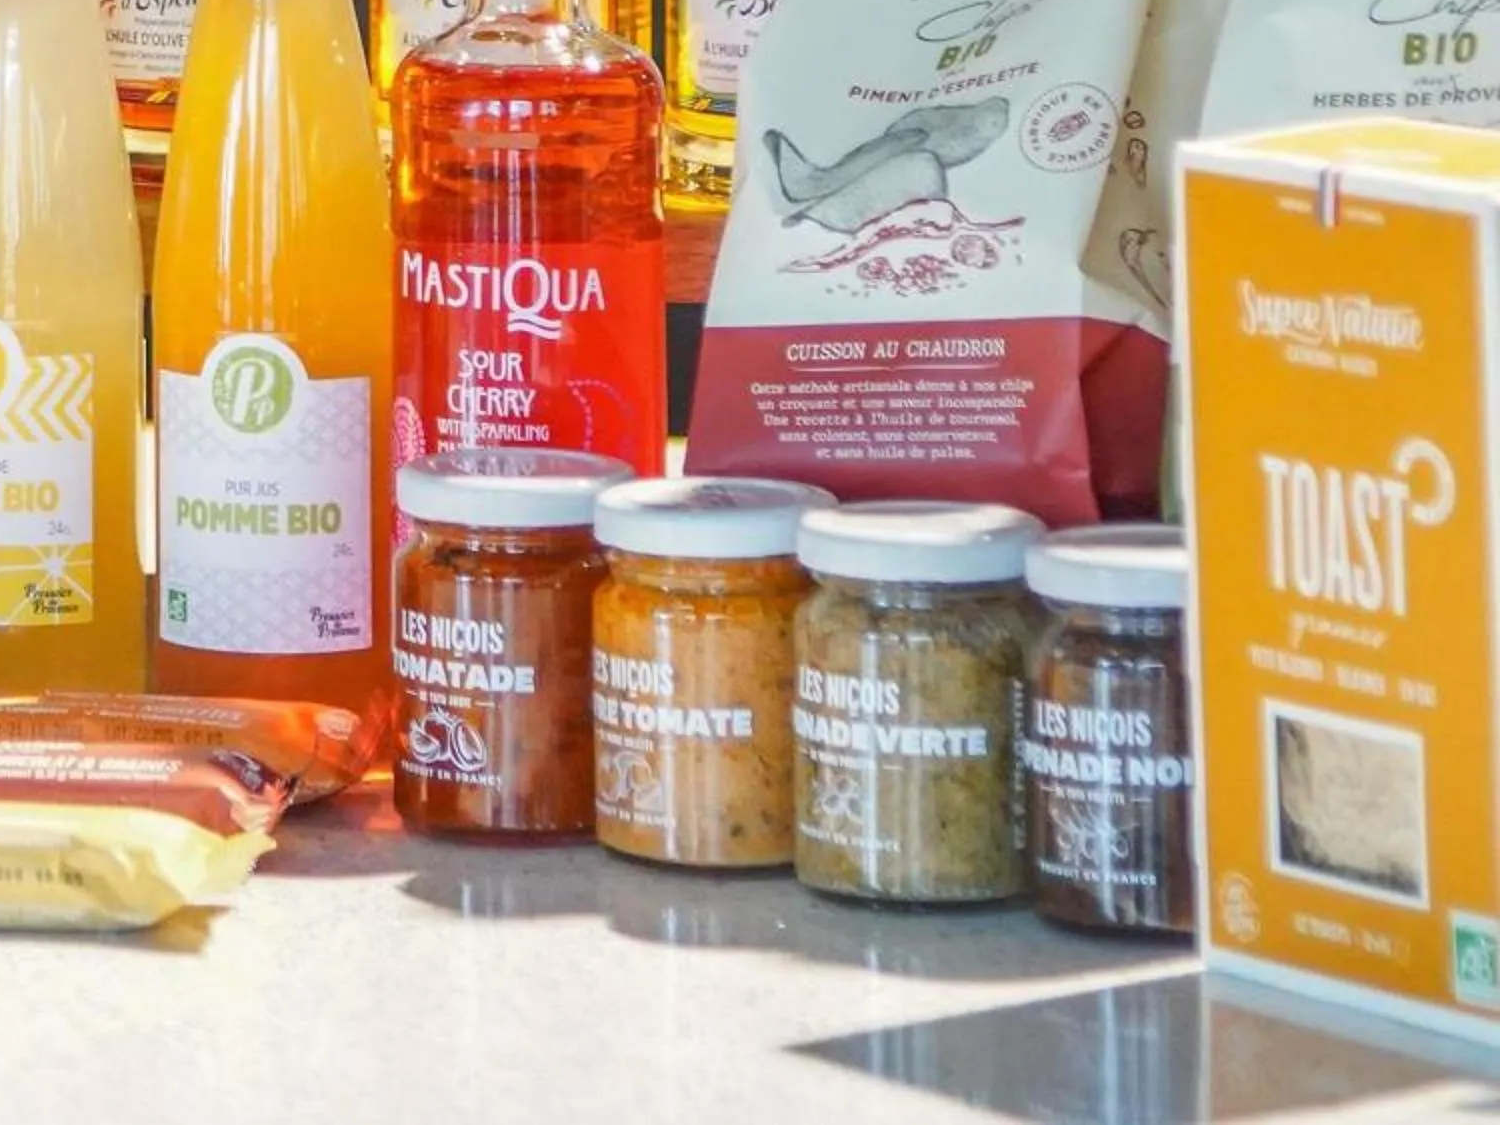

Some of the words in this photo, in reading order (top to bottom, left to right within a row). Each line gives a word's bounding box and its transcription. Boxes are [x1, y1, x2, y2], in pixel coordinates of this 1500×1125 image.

[936, 33, 997, 71] BIO
[1403, 32, 1478, 66] BIO
[848, 85, 924, 104] PIMENT
[928, 62, 1040, 100] D'ESPELETTE
[1313, 92, 1397, 109] HERBES
[1404, 91, 1433, 108] DE
[402, 250, 605, 339] MASTIQUA
[457, 348, 524, 382] SOUR
[786, 342, 866, 361] CUISSON
[873, 342, 899, 359] AU
[906, 339, 1006, 359] CHAUDRON
[446, 384, 536, 417] CHERRY
[3, 480, 60, 512] BIO
[225, 479, 250, 495] PUR
[256, 480, 280, 497] JUS
[177, 496, 279, 536] POMME
[287, 502, 341, 536] BIO
[402, 608, 428, 646] LES
[431, 615, 505, 658] NIÇOIS
[394, 649, 536, 694] TOMATADE
[610, 654, 674, 698] NIÇOIS
[800, 666, 824, 704] LES
[826, 672, 901, 717] NIÇOIS
[620, 699, 753, 738] TOMATE
[1036, 701, 1067, 739] LES
[1070, 706, 1152, 751] NIÇOIS
[876, 725, 987, 757] VERTE
[1130, 755, 1195, 788] NOI
